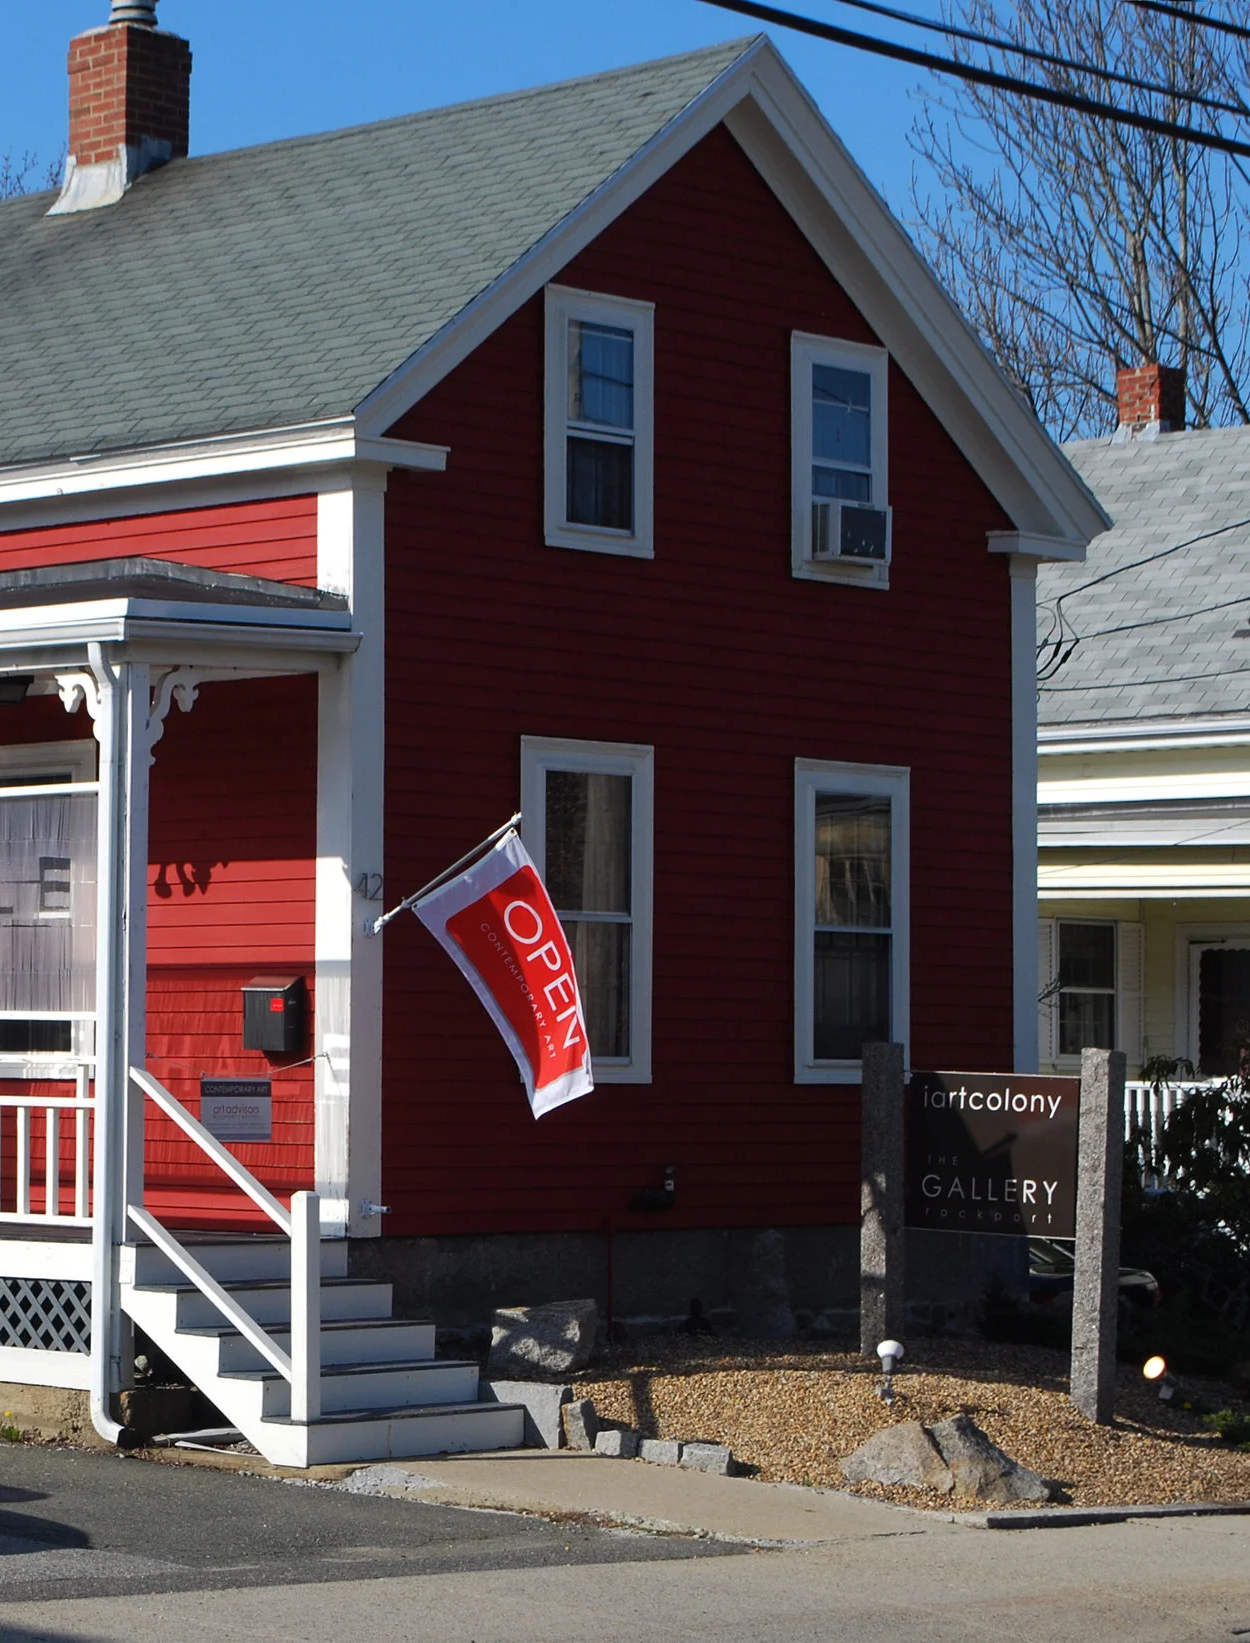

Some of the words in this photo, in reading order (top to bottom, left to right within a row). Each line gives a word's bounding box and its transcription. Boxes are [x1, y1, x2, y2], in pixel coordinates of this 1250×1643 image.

[354, 873, 382, 900] 42
[480, 922, 547, 1028] CONTEMPORARY
[544, 1034, 557, 1059] ART
[503, 900, 580, 1050] OPEN
[923, 1085, 1062, 1119] iartcolony
[927, 1155, 958, 1166] THE
[921, 1174, 1058, 1205] GALLERY
[925, 1207, 1052, 1224] rockport
